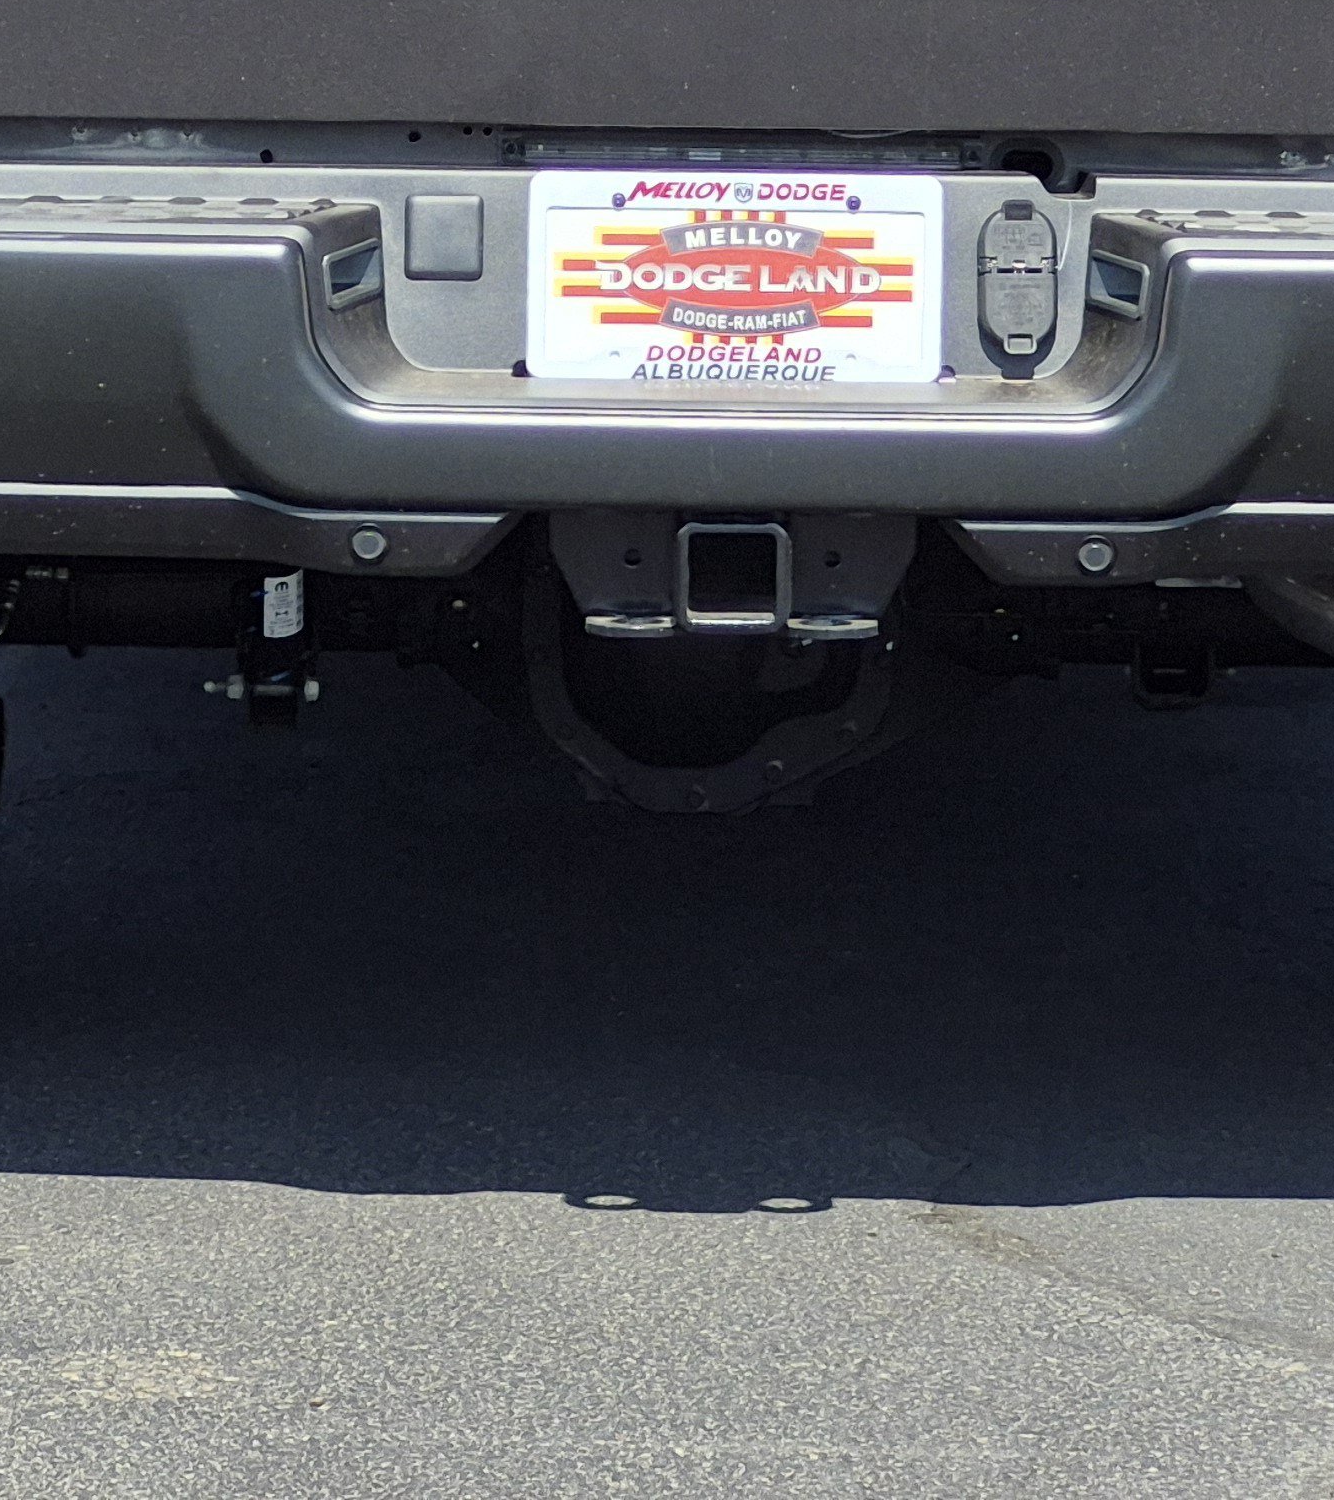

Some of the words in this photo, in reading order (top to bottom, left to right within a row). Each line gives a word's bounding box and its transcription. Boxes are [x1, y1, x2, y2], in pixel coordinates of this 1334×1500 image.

[627, 180, 732, 203] MELLOY
[757, 182, 847, 201] DODGE
[684, 226, 803, 250] MELLOY
[594, 260, 754, 292] DODGE
[758, 264, 883, 295] LAND
[672, 307, 807, 331] DODGE-RAM-FIAT
[646, 344, 822, 363] DODGELAND
[631, 363, 837, 382] ALBUQUERQUE
